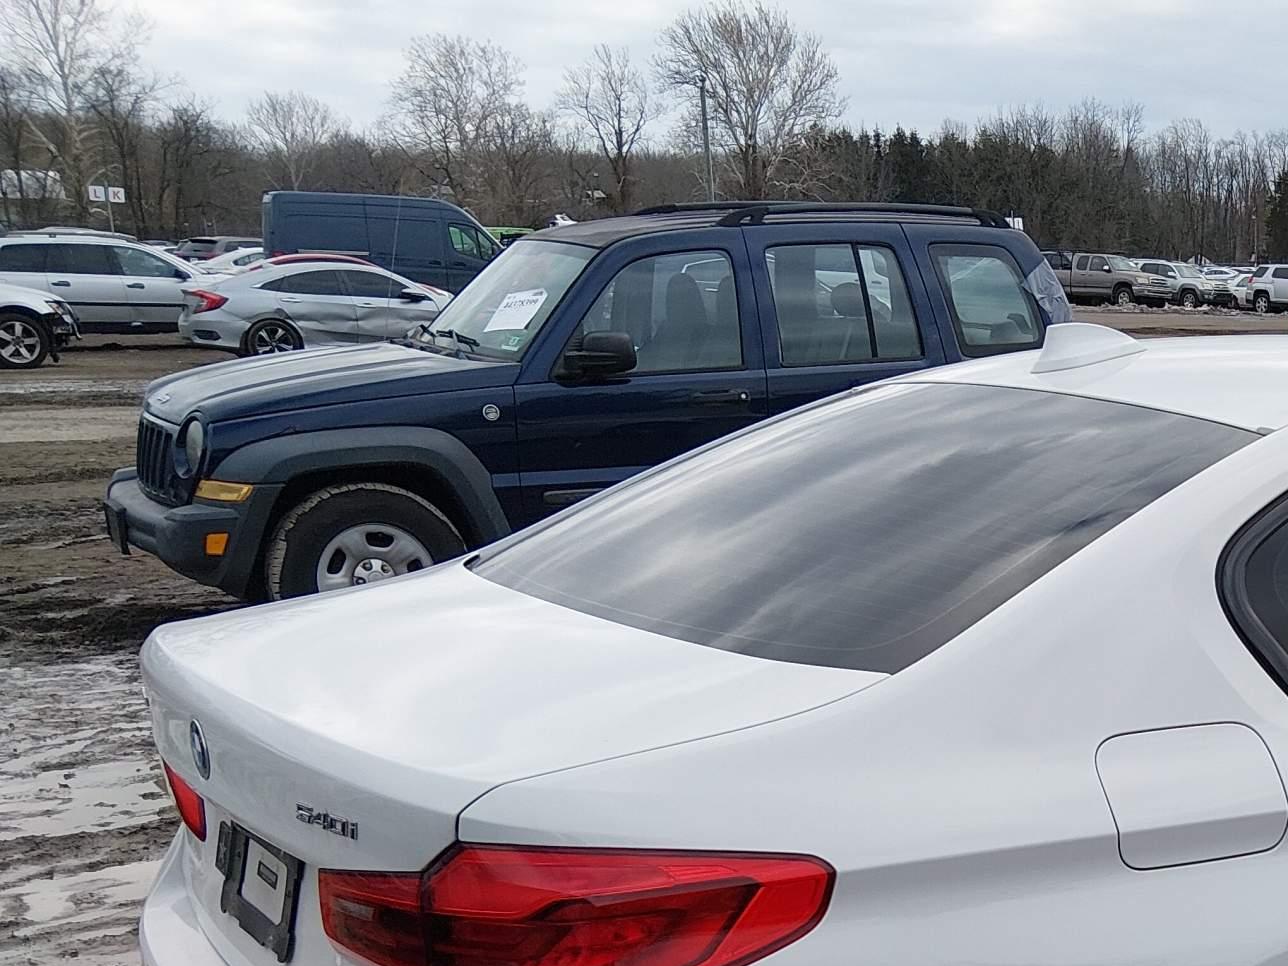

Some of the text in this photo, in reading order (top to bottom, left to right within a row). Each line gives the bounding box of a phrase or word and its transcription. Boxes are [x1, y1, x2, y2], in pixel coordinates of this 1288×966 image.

[93, 188, 102, 199] L
[112, 190, 121, 200] K
[296, 801, 359, 841] 540i
